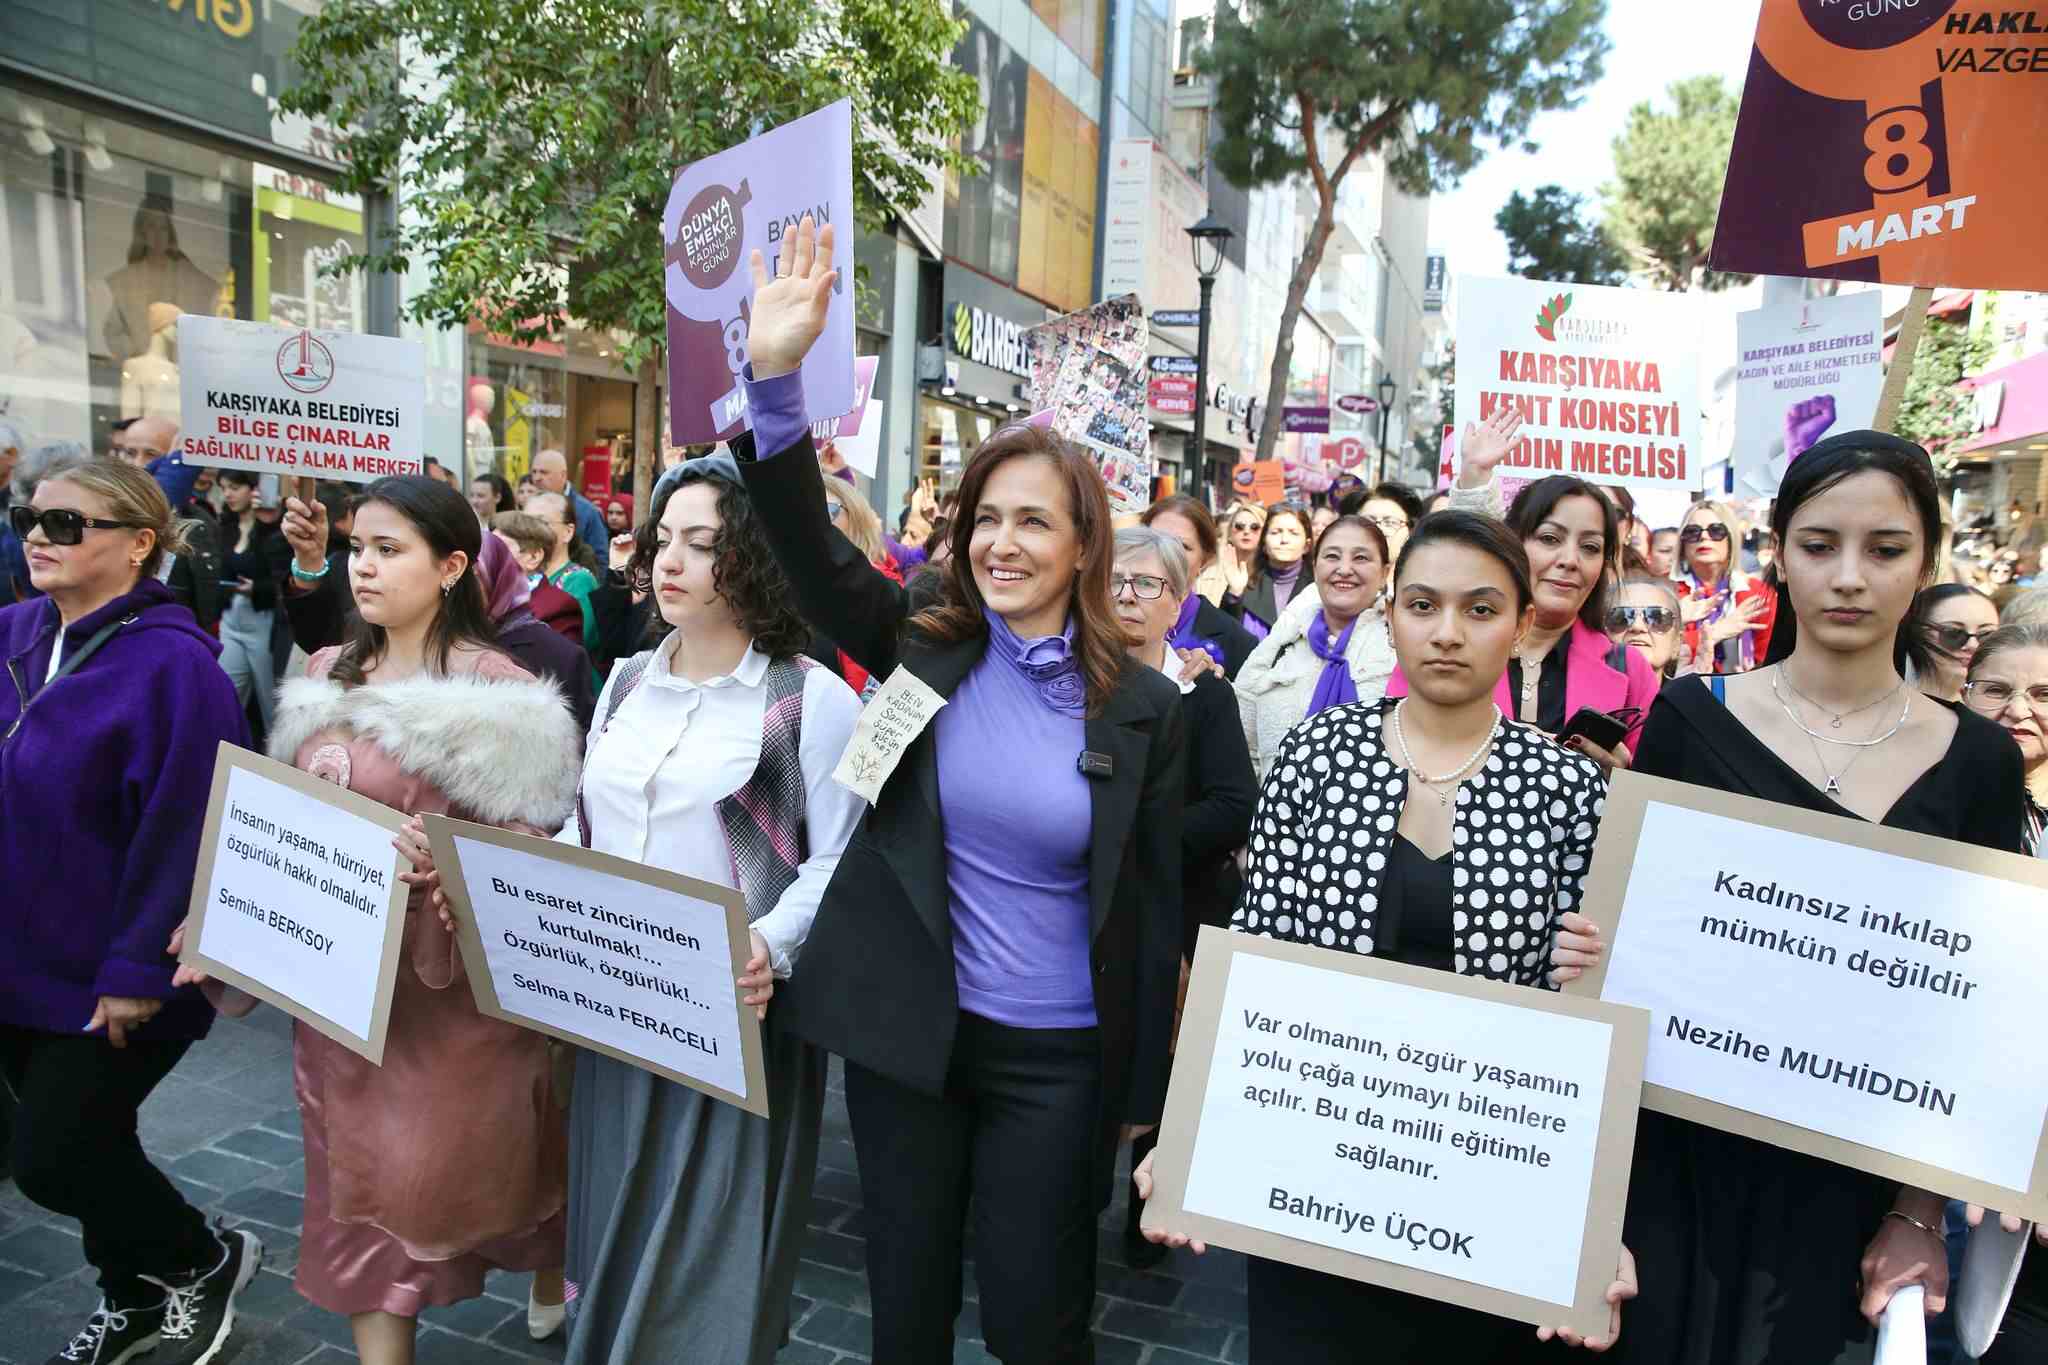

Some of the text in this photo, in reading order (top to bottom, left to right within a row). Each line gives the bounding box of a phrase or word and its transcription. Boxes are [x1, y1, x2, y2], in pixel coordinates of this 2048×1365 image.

[1944, 12, 2048, 35] HAKL
[1864, 106, 1933, 193] 8
[682, 196, 730, 240] DÜNYA
[1836, 195, 1977, 256] MART
[689, 226, 736, 269] KADINLAR
[1500, 350, 1661, 393] KARŞIYAKA
[1743, 331, 1874, 362] KARŞIYAKA BELEDİYESİ
[1772, 364, 1785, 375] VE
[207, 390, 400, 428] KARŞIYAKA BELEDİYESİ
[726, 387, 748, 420] MA
[1480, 392, 1679, 437] KENT KONSEYİ
[184, 436, 421, 478] SAĞLIKLI YAŞ ALMA MERKEZİ
[218, 415, 391, 451] BİLGE ÇINARLAR
[1497, 437, 1686, 480] DIN MECLİSİ
[901, 689, 923, 708] BEN
[229, 800, 276, 837] İnsanın
[279, 828, 329, 861] yaşama,
[227, 835, 379, 919] özgürlük hakkı olmalıdır.
[218, 887, 334, 956] Semiha BERKSOY
[491, 877, 701, 951] Bu esaret zincirinden
[537, 915, 662, 966] kurtulmak!...
[1714, 870, 1973, 957] Kadınsız inkılap
[503, 930, 711, 1010] Özgürlük, özgürlük!...
[1700, 914, 1977, 1001] mümkün değildir
[512, 973, 718, 1056] Selma Rıza FERACELİ
[1243, 1009, 1580, 1099] Var olmanın, özgür yaşamın
[1665, 1015, 1957, 1117] Nezihe MUHİDDİN
[1240, 1047, 1567, 1134] yolu çağa uymayı bilenlere
[1243, 1082, 1551, 1168] açılır. Bu da milli eğitimle
[1335, 1140, 1439, 1181] sağlanır.
[1268, 1187, 1475, 1259] Bahriye ÜÇOK
